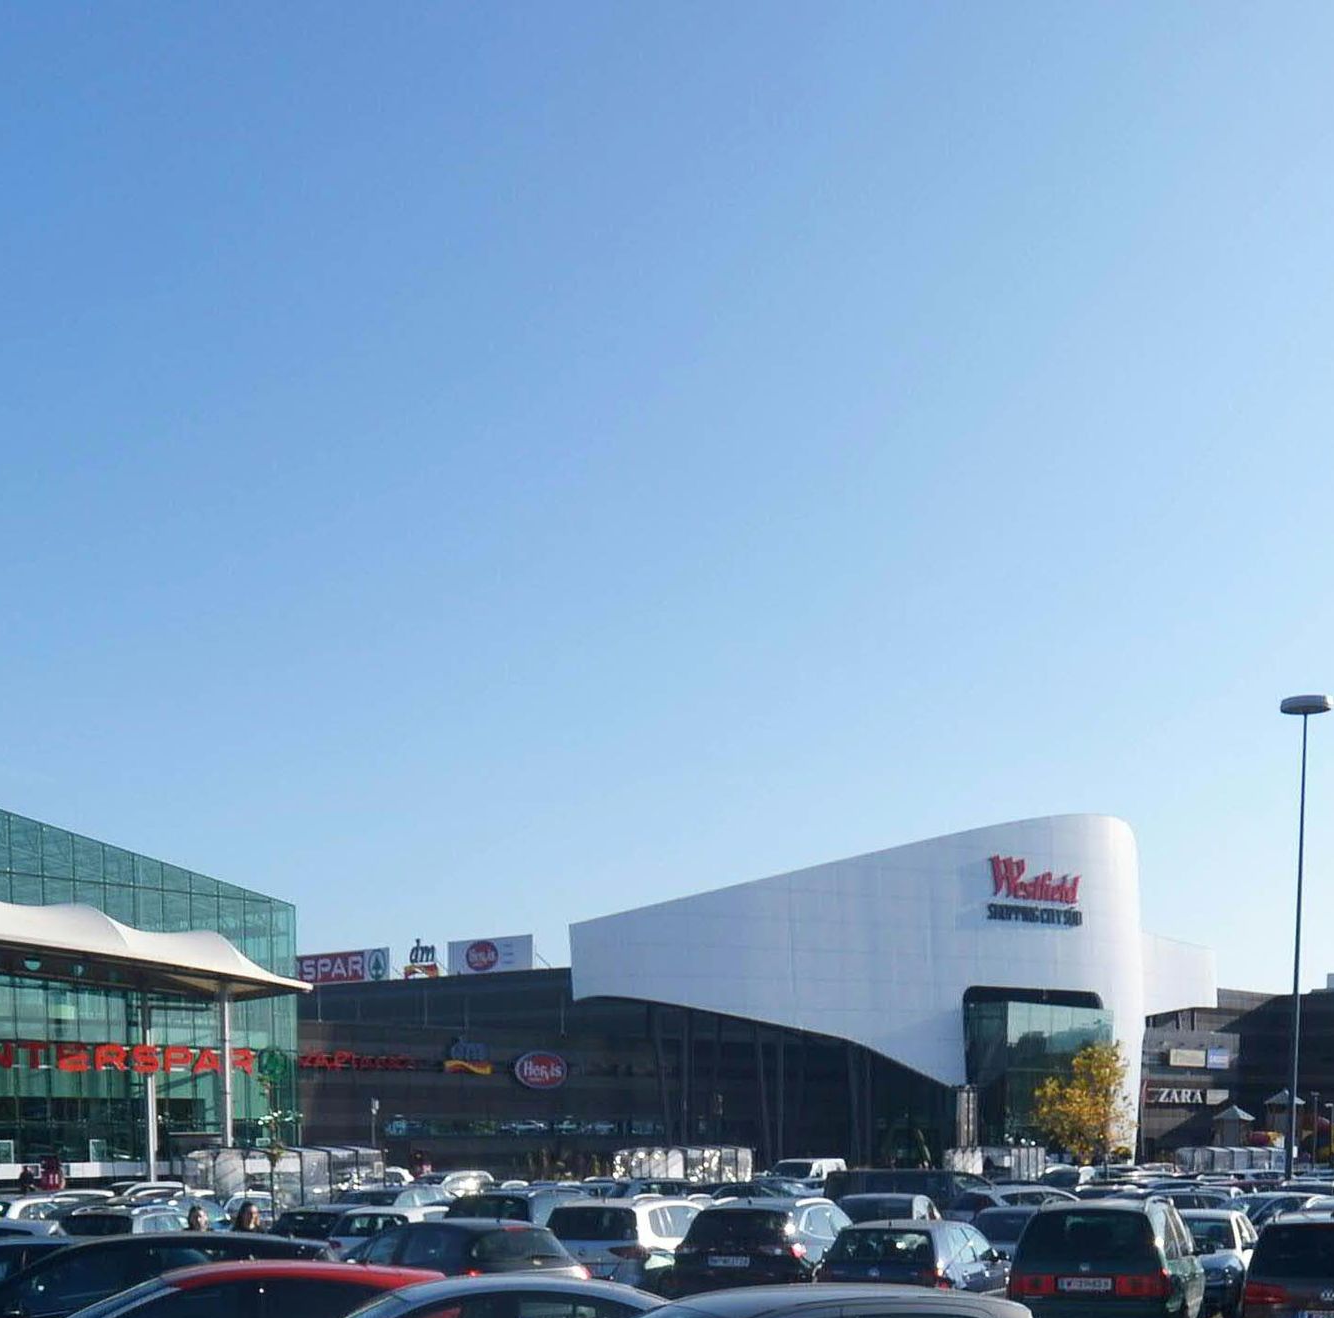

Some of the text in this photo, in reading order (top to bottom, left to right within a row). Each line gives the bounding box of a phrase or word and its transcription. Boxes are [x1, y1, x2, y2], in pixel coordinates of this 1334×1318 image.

[988, 854, 1081, 904] Westfield
[987, 903, 1039, 922] SHOPPING
[1040, 908, 1062, 924] CITY
[410, 938, 435, 963] dm
[1158, 1088, 1203, 1104] ZARA
